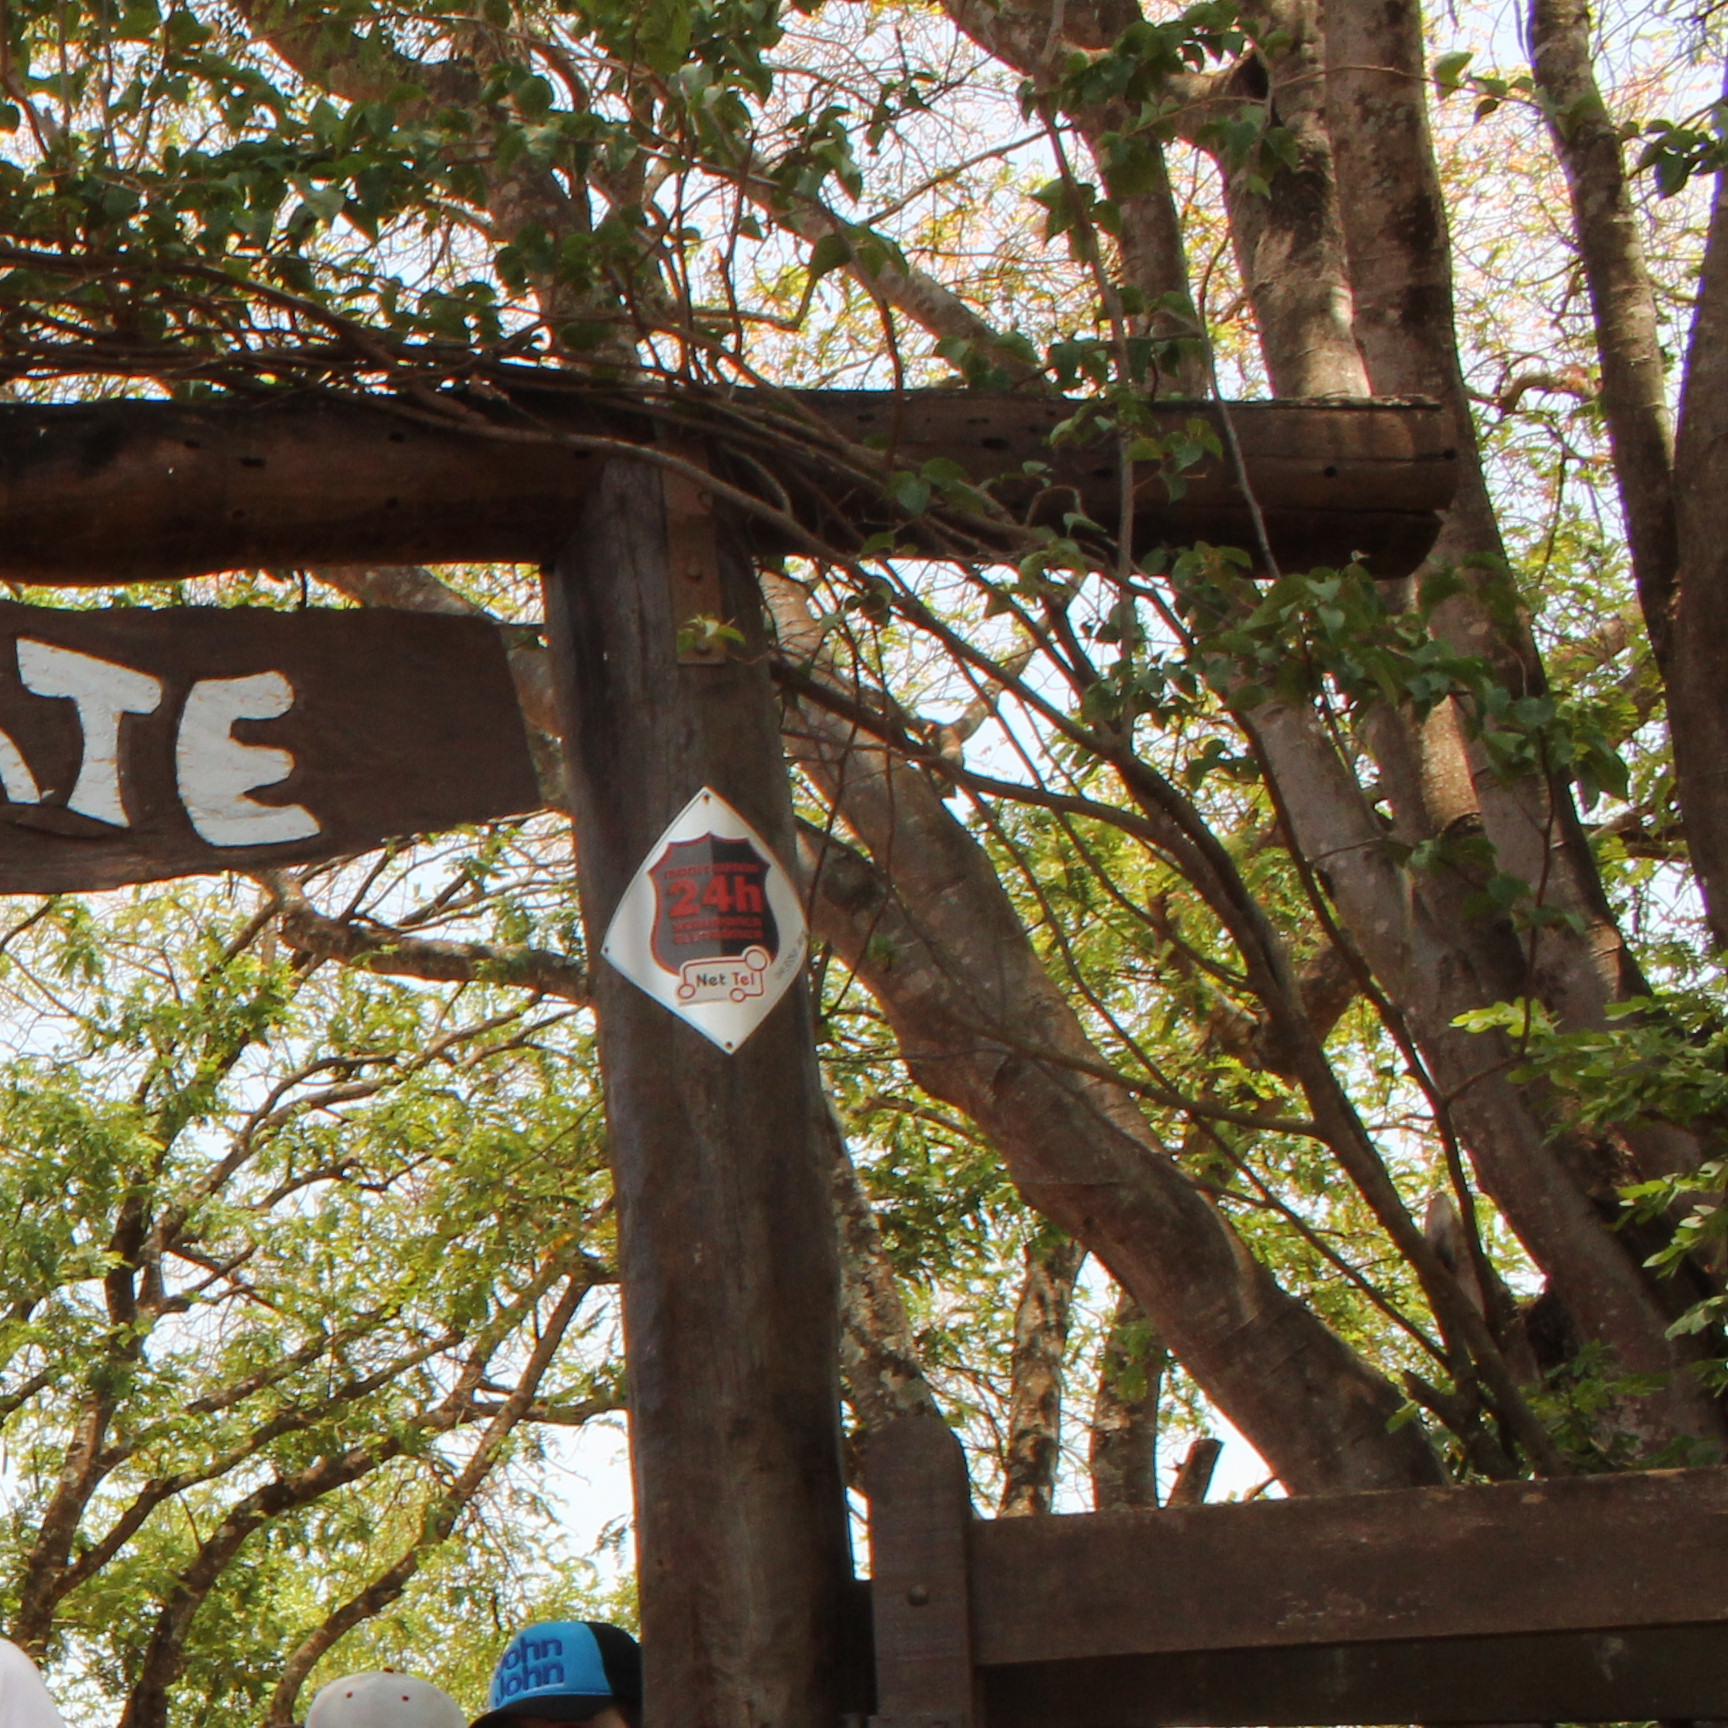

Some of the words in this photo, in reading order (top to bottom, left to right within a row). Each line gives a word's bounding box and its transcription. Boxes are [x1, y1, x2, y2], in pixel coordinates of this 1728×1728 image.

[668, 874, 763, 918] 24h
[696, 973, 726, 988] Net
[731, 972, 755, 986] Tel
